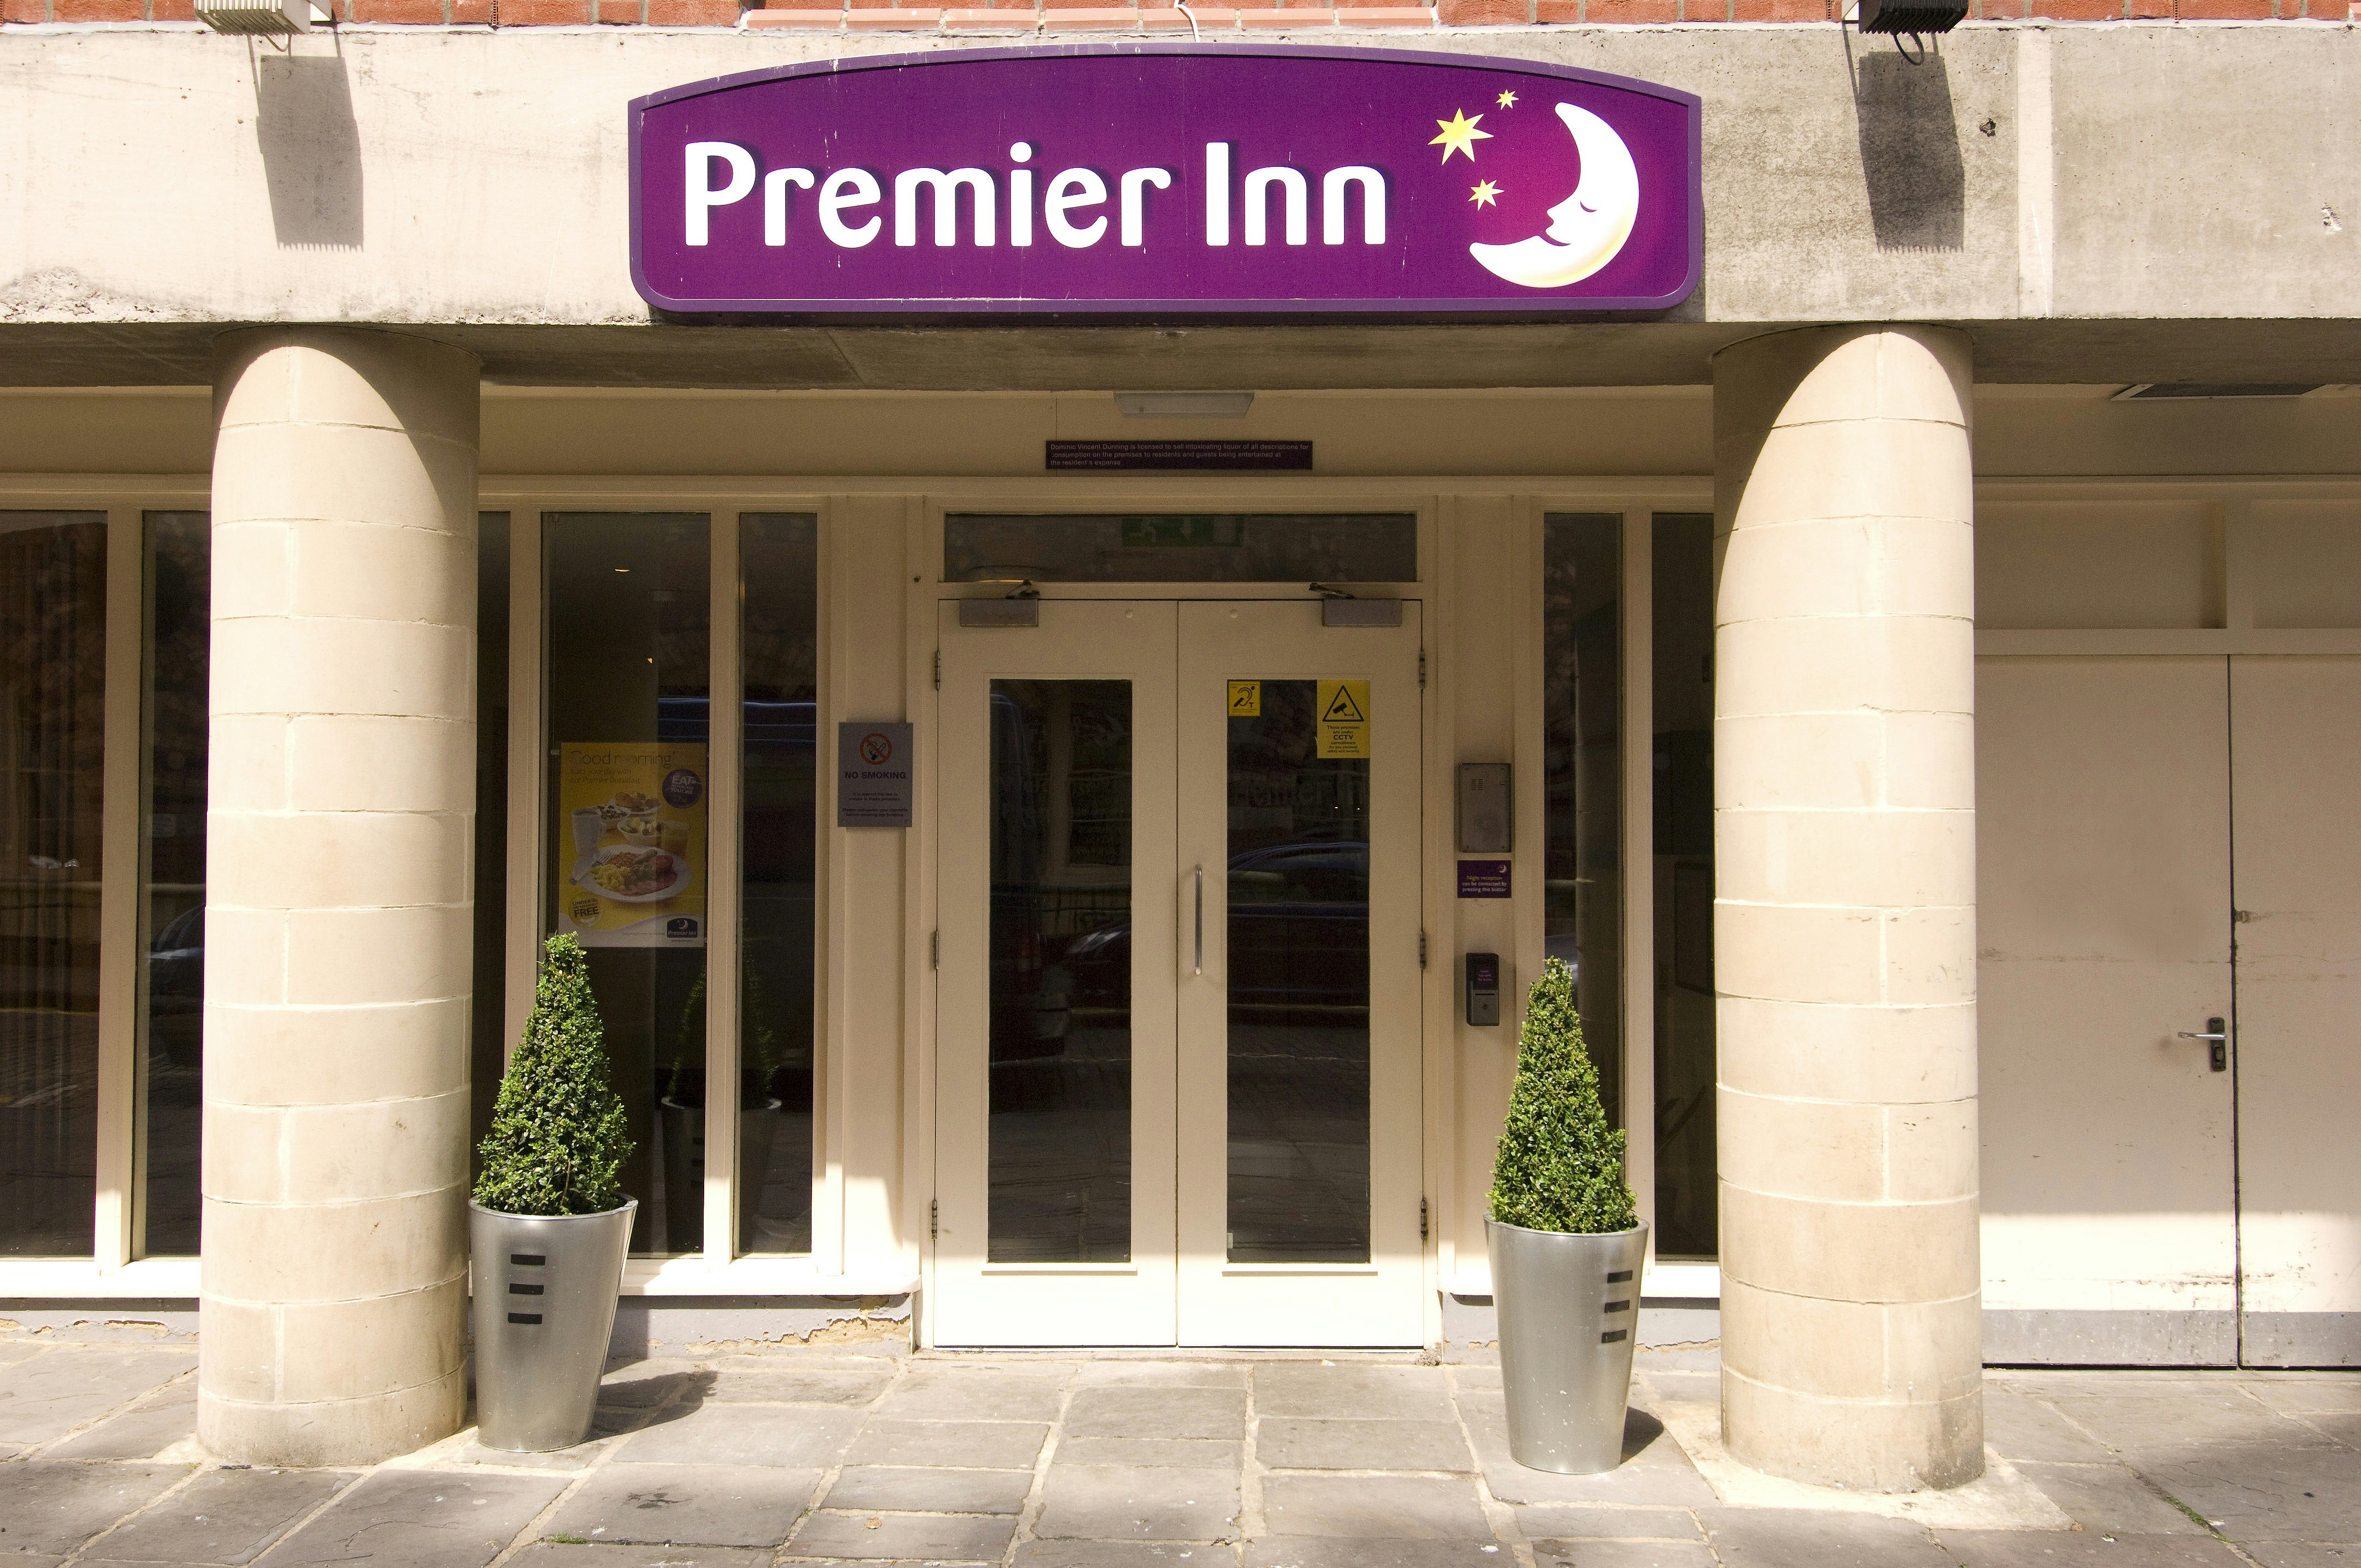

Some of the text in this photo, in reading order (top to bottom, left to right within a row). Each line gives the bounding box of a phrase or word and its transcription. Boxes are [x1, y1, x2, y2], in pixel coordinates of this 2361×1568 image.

[686, 141, 1386, 248] Premier Inn
[672, 775, 695, 786] EAT
[574, 906, 599, 918] FREE
